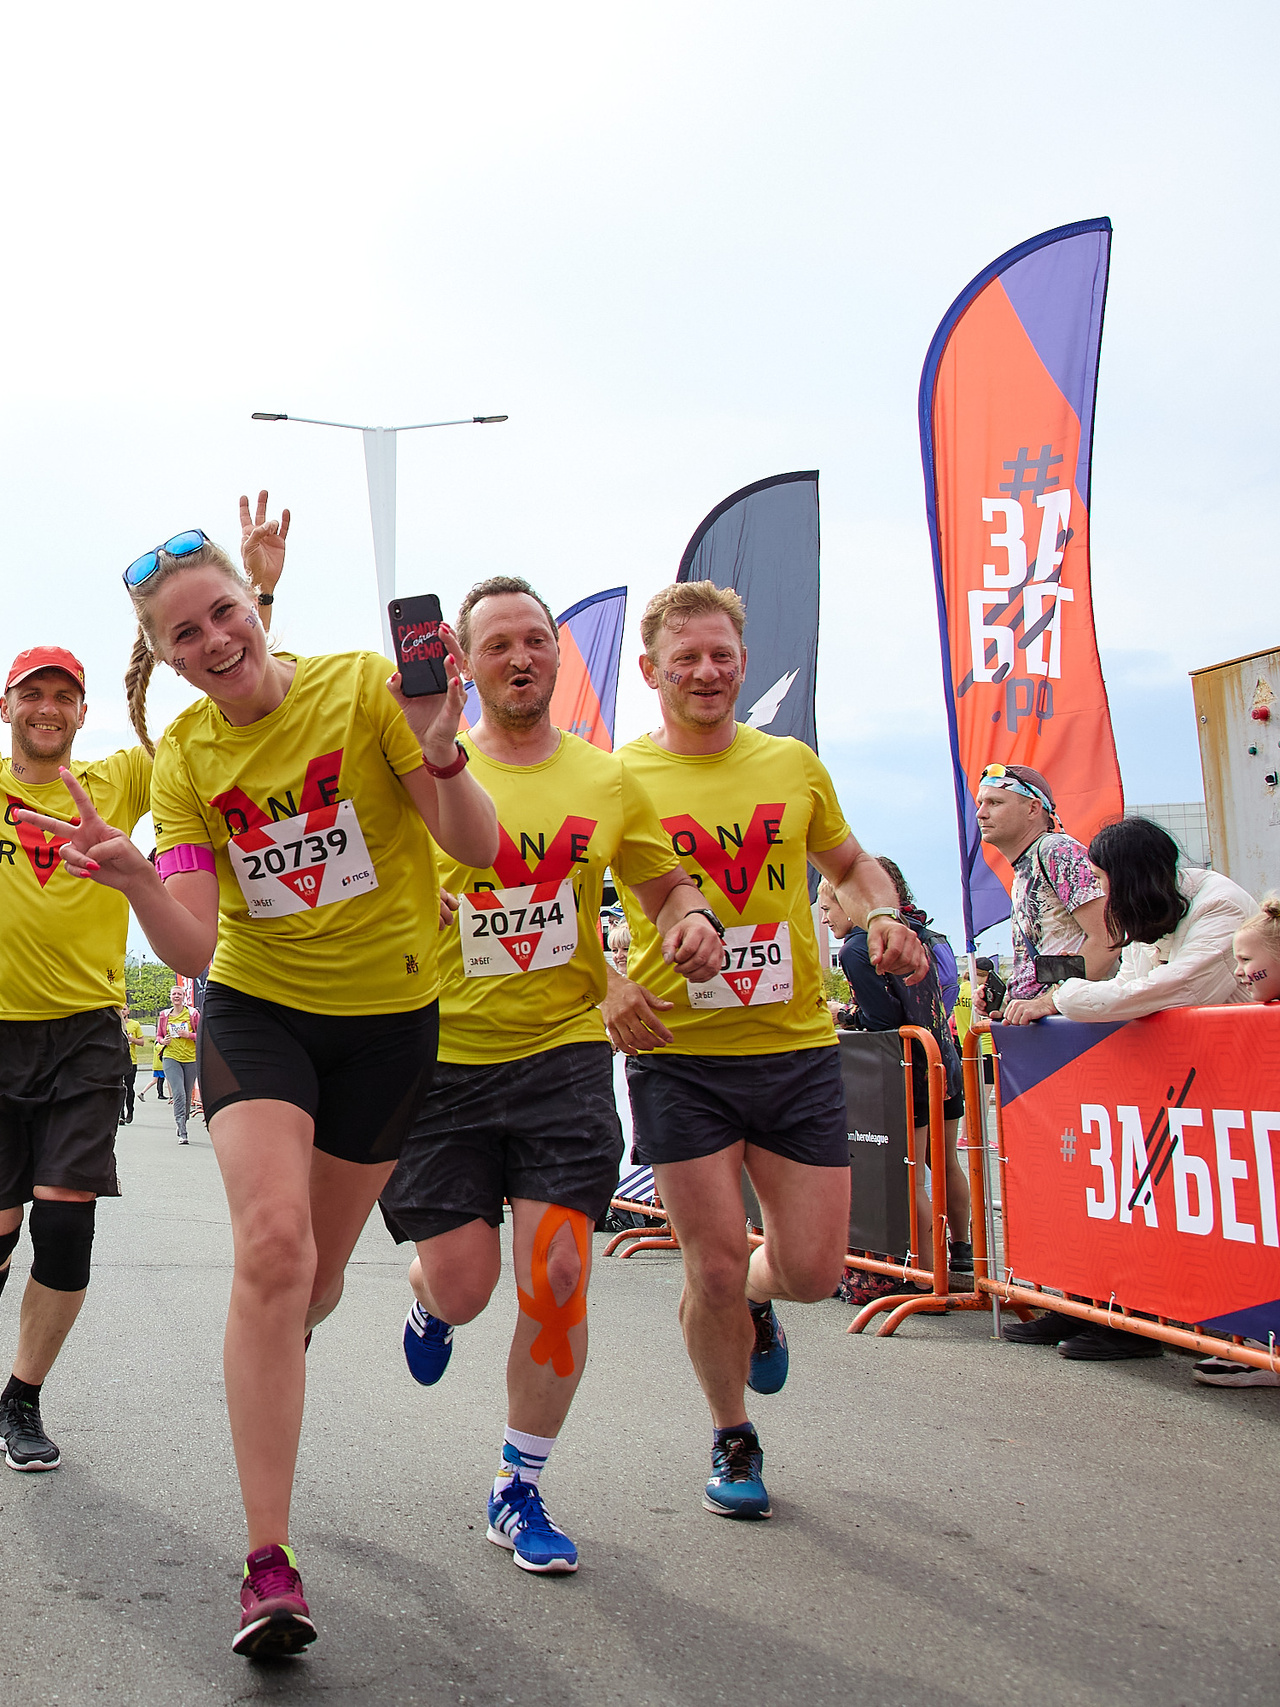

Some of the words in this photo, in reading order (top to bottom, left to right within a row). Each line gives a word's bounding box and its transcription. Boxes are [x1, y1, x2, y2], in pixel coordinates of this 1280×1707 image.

[401, 641, 444, 663] ВРЕМЯ
[224, 775, 346, 837] ONE
[520, 832, 589, 864] NE
[672, 819, 784, 857] ONE
[241, 828, 348, 881] 20739
[293, 874, 317, 892] 10
[352, 870, 370, 882] ПСБ
[471, 902, 565, 938] 20744
[511, 941, 531, 956] 10
[561, 942, 575, 952] ПСБ
[720, 943, 782, 971] 0750
[733, 977, 752, 990] 10
